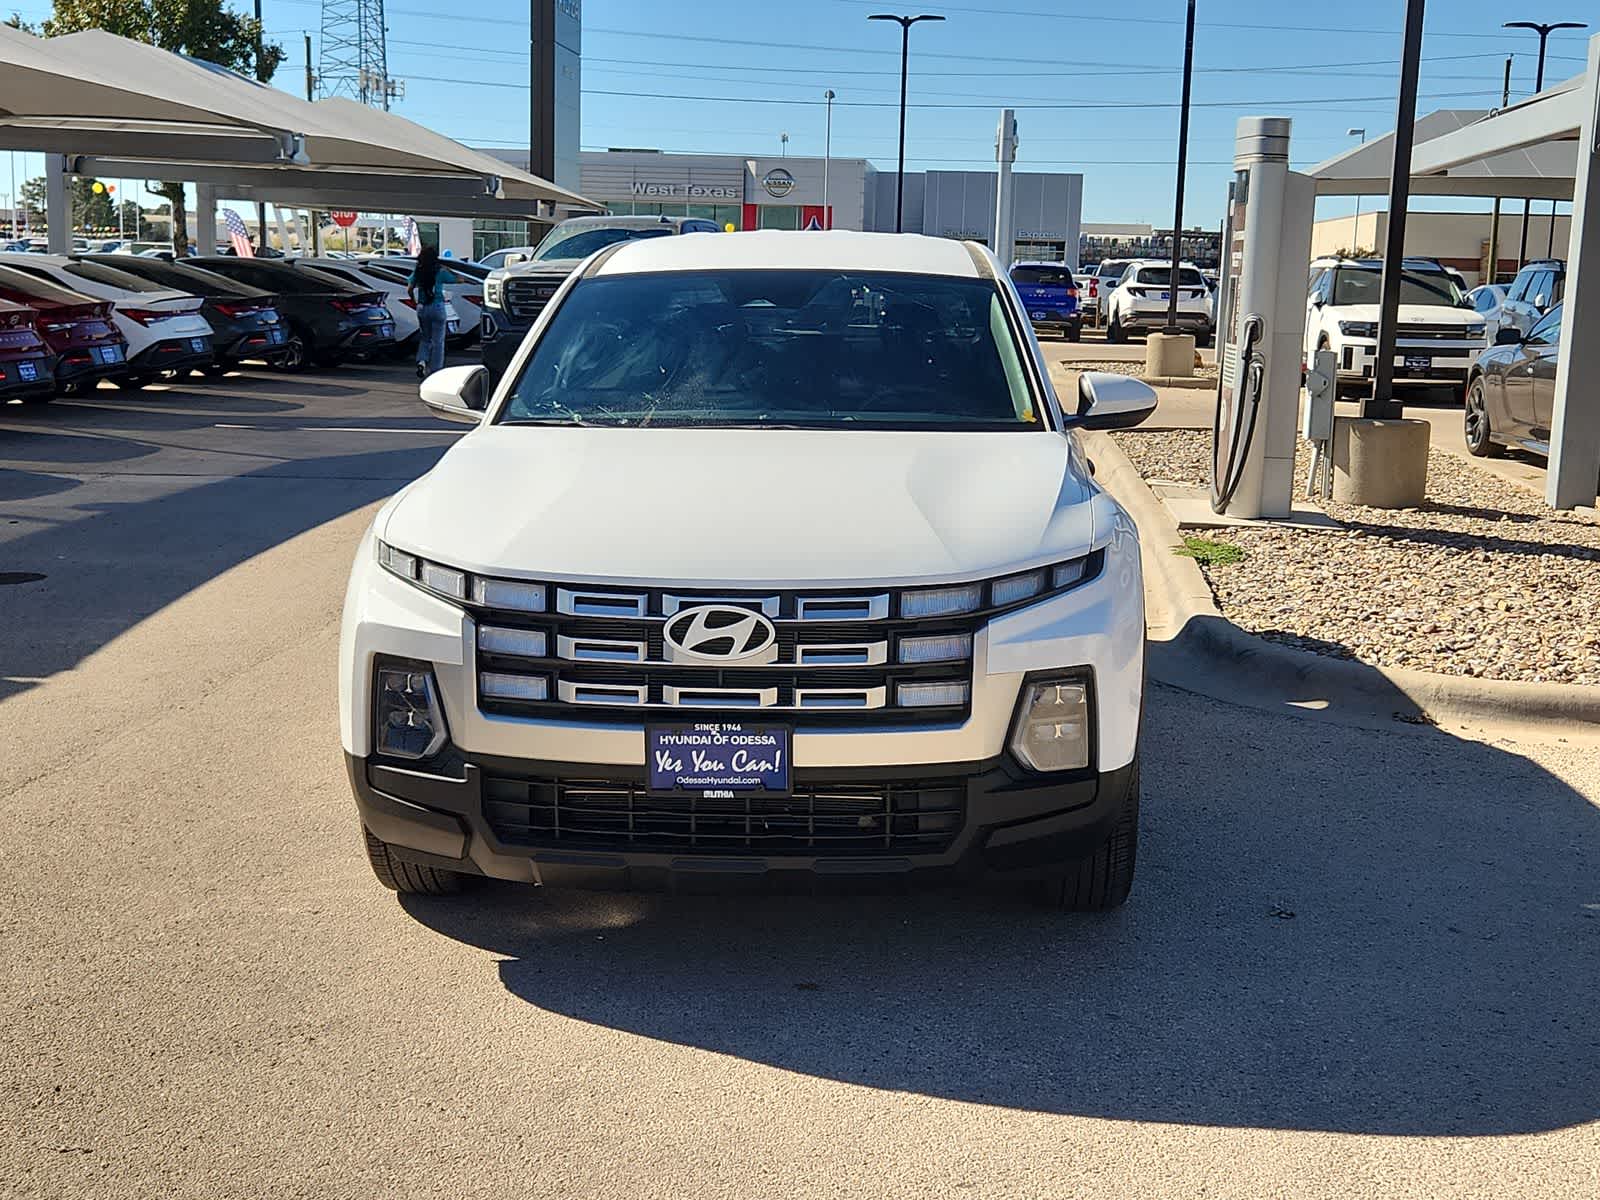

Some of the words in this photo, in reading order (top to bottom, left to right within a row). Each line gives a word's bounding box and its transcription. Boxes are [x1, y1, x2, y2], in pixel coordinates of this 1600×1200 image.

[630, 182, 675, 196] West
[685, 184, 737, 198] Texas
[694, 723, 720, 731] SINCE
[722, 723, 742, 731] 1946
[660, 735, 711, 745] HYUNDAI
[713, 735, 729, 745] OF
[731, 736, 776, 745] ODESSA
[655, 749, 683, 772] Yes
[691, 749, 725, 772] You
[731, 749, 781, 772] Can!
[676, 776, 761, 785] OdessaHyundai.com
